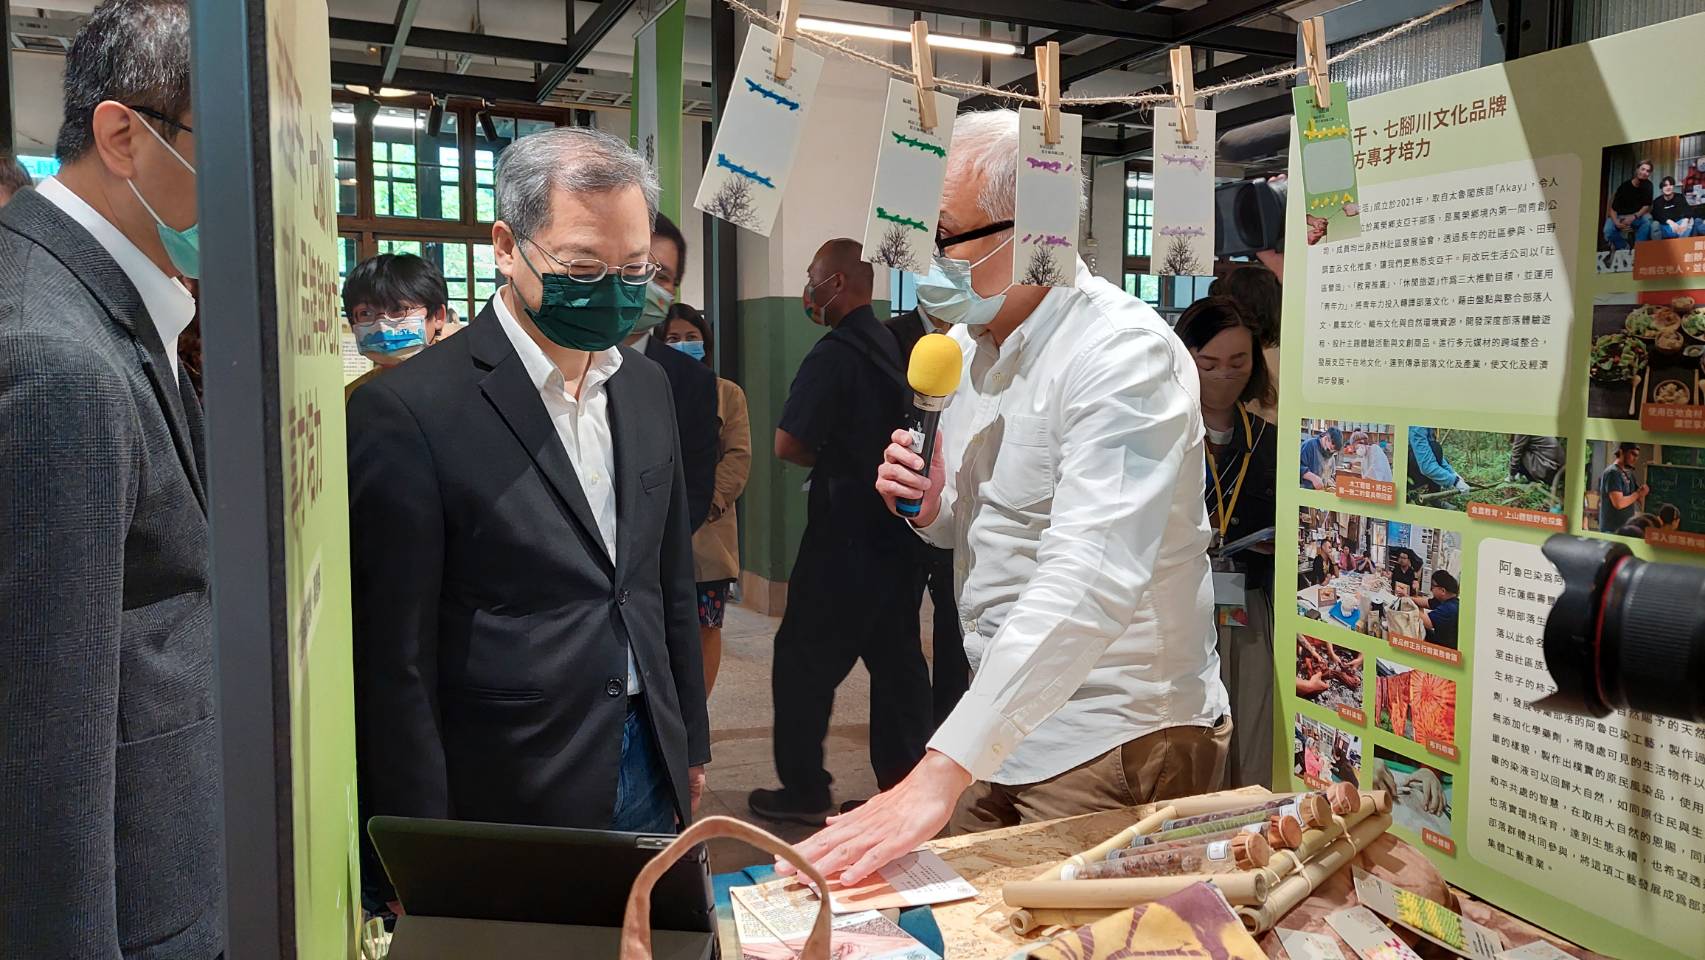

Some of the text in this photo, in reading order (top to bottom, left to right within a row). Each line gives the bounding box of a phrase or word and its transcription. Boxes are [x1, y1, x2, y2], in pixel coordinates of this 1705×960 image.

[1354, 138, 1431, 170] 方專才培力
